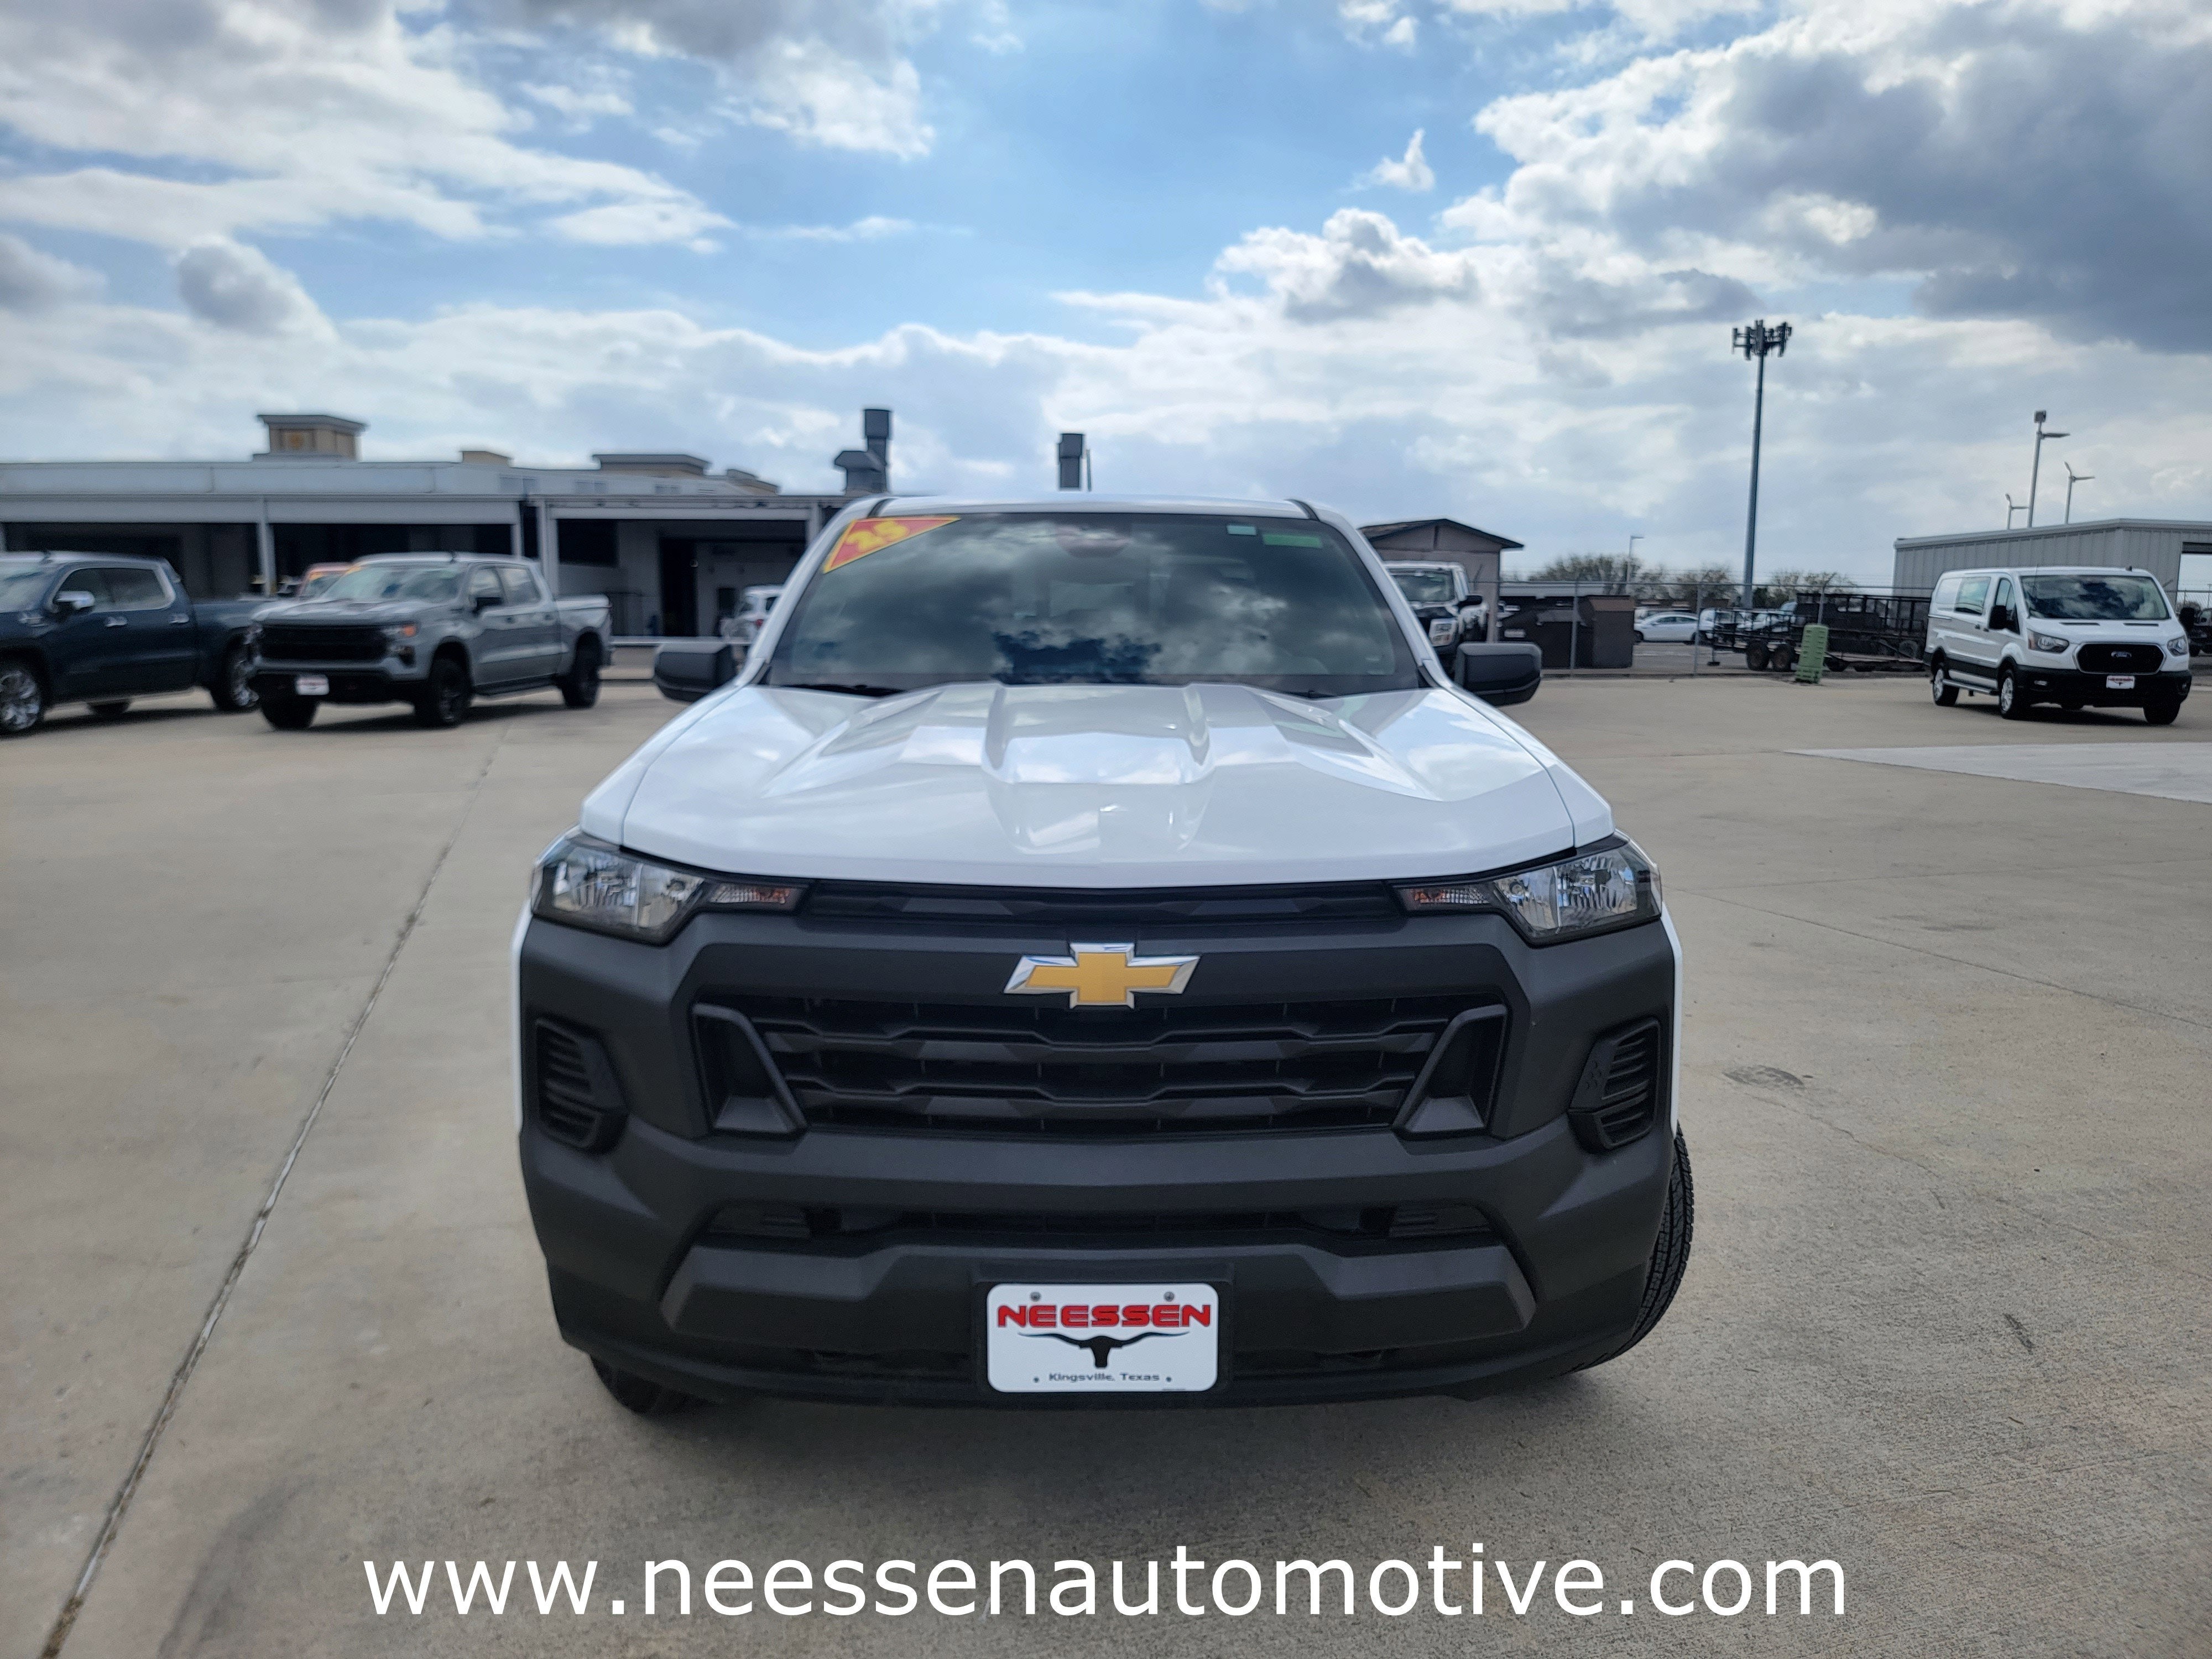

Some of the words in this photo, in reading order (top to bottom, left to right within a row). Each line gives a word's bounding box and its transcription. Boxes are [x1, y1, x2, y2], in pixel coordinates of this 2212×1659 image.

[998, 1305, 1211, 1327] NEESSEN
[1048, 1373, 1115, 1383] Kingsville,
[1120, 1372, 1160, 1381] Texas
